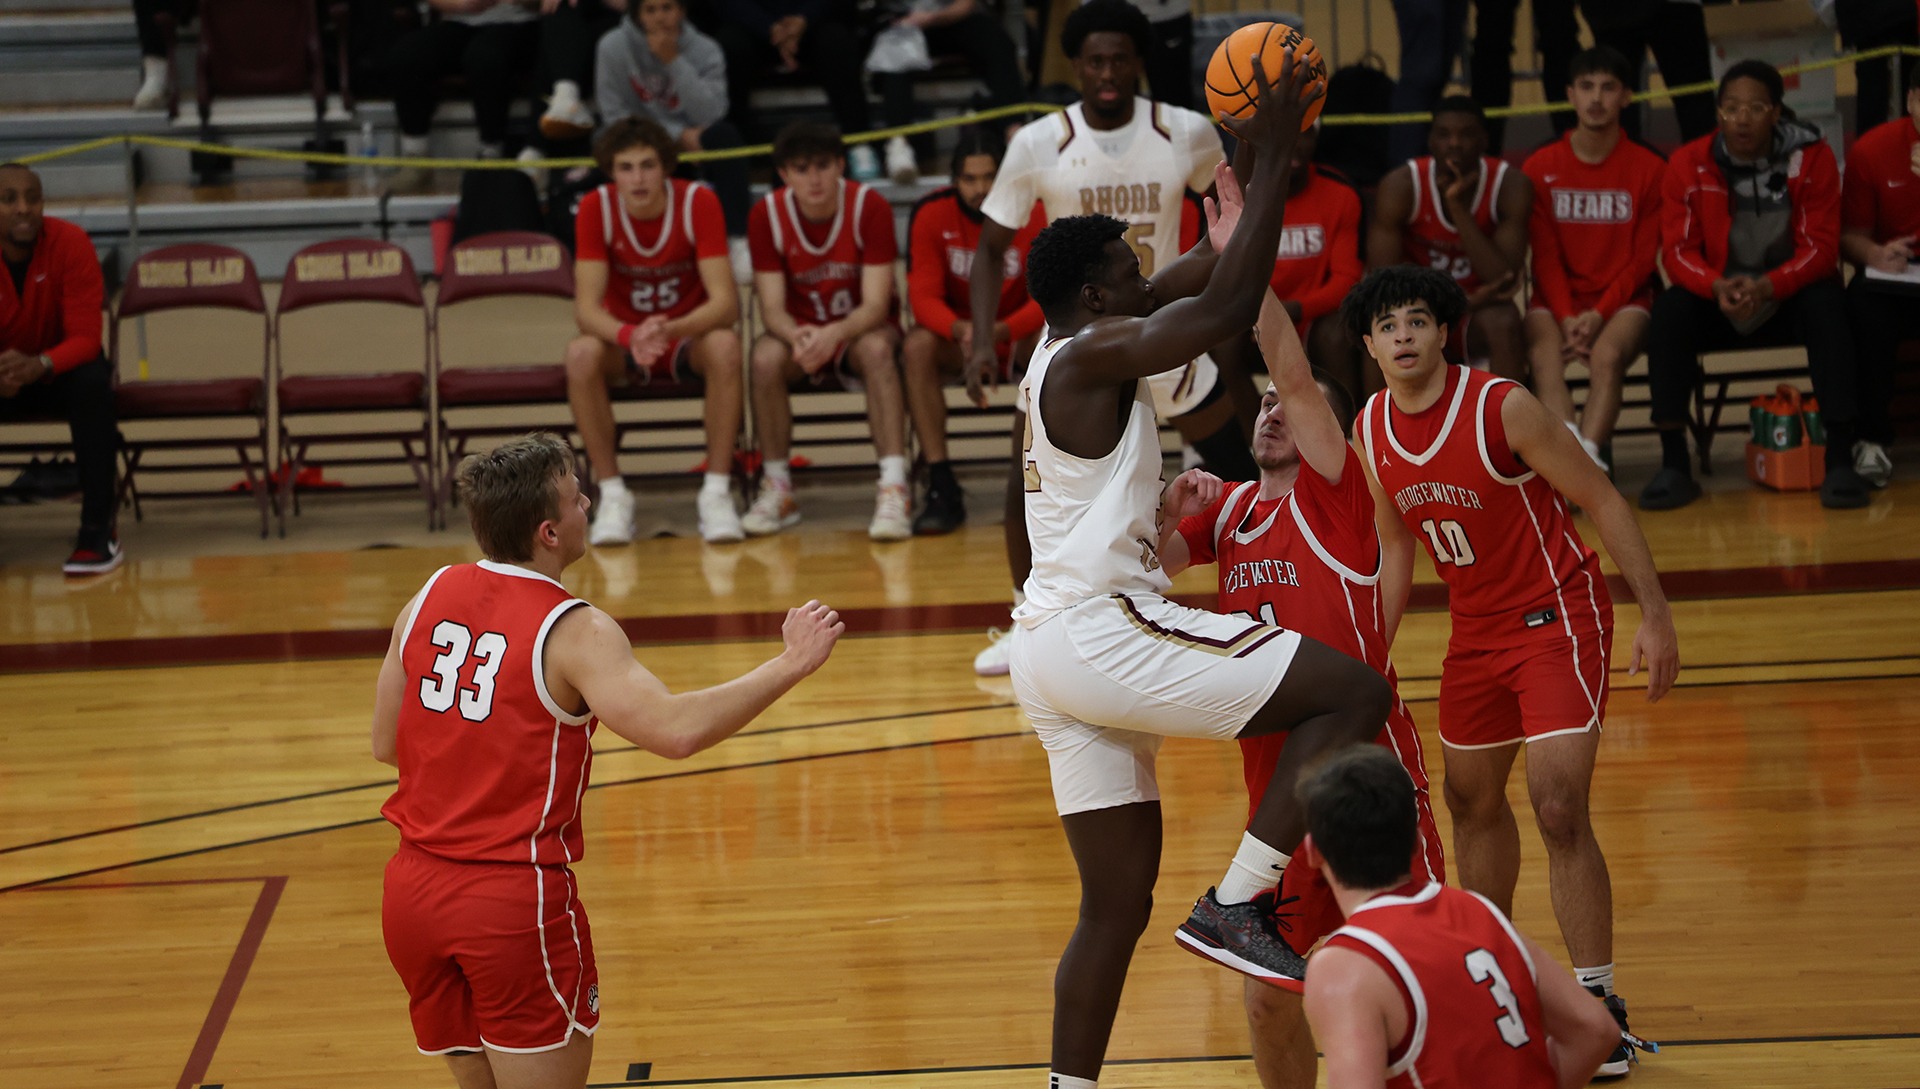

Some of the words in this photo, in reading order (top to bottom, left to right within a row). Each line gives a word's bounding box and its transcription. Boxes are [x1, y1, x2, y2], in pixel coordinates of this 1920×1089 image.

[1079, 182, 1161, 216] RHODE
[1555, 191, 1630, 220] BEARS
[1123, 222, 1155, 280] 5
[1279, 227, 1323, 256] ARS
[630, 276, 681, 312] 25
[1394, 481, 1483, 515] BRIDGEWATER
[1421, 518, 1477, 568] 10
[419, 619, 508, 723] 33
[1464, 947, 1531, 1049] 3
